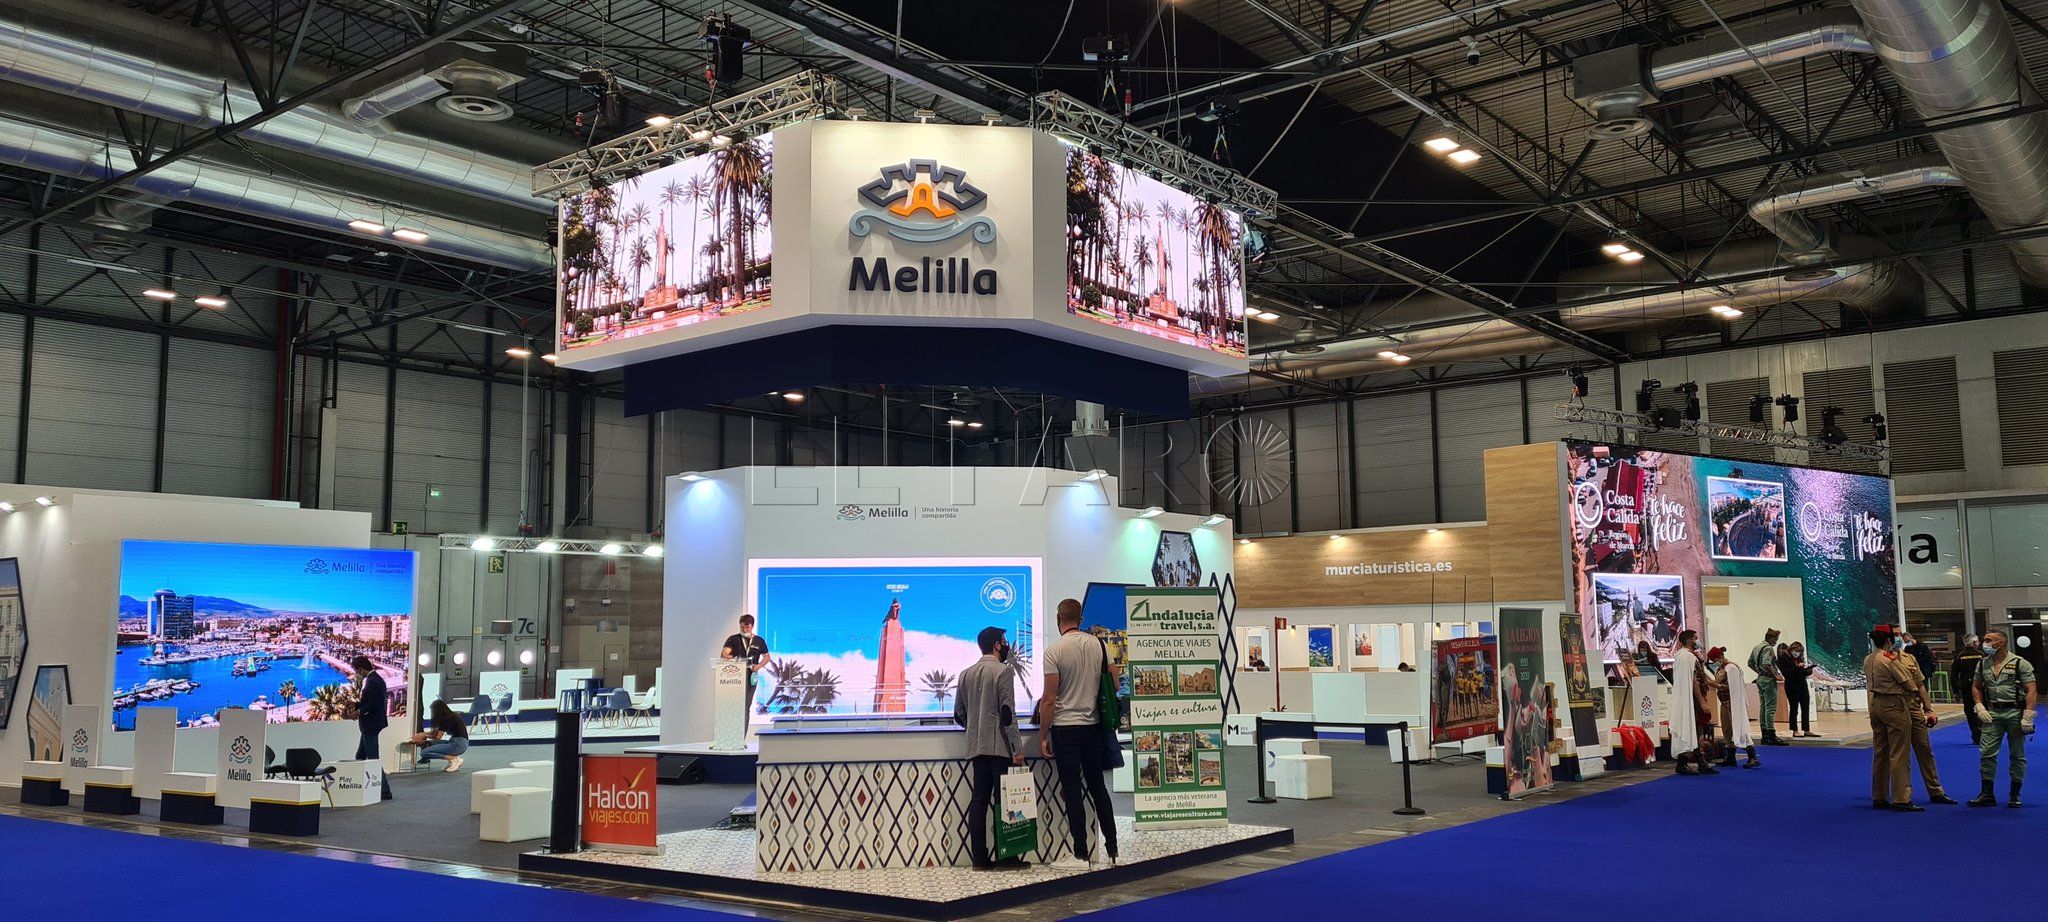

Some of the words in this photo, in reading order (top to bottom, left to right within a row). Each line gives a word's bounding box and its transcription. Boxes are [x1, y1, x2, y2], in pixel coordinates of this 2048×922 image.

[849, 256, 997, 295] Melilla
[1606, 489, 1635, 506] Costa
[868, 507, 909, 518] Melilla
[1660, 494, 1686, 518] hace
[921, 512, 957, 520] compartida
[1650, 514, 1688, 551] feliz
[1857, 529, 1885, 561] feliz
[331, 562, 365, 573] Melilla
[1325, 560, 1453, 576] murciaturistica.es
[1136, 639, 1172, 648] AGENCIA
[1173, 639, 1185, 647] DE
[1186, 638, 1211, 648] VIAJES
[1154, 650, 1196, 659] MELILLA
[1135, 706, 1167, 722] Viajar
[1170, 707, 1179, 715] es
[1182, 701, 1218, 715] cultura
[227, 768, 252, 781] Melilla
[339, 776, 353, 784] Play
[588, 779, 649, 809] Halcón
[1144, 794, 1152, 802] La
[1153, 794, 1177, 803] agencia
[1177, 793, 1190, 801] más
[1175, 801, 1196, 809] Melilla
[588, 810, 649, 828] viajes.com
